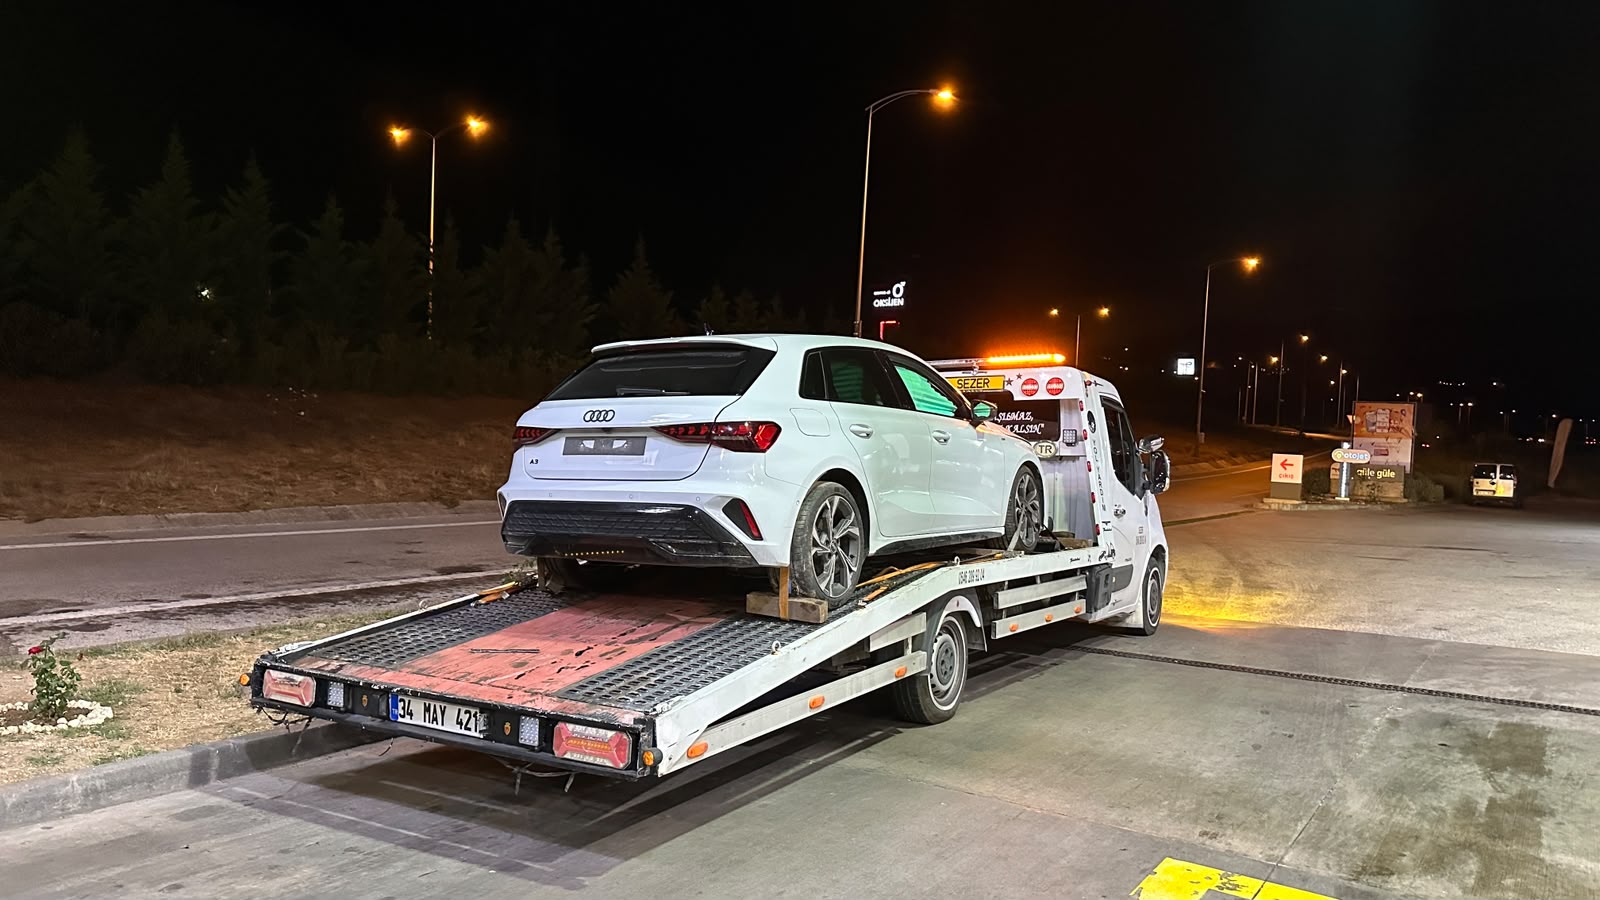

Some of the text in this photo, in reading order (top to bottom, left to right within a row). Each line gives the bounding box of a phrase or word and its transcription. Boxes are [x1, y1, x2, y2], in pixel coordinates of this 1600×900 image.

[956, 378, 990, 389] SEZER
[1038, 445, 1053, 454] TR
[1376, 469, 1396, 479] güle
[398, 698, 479, 733] 34 MAY 421
